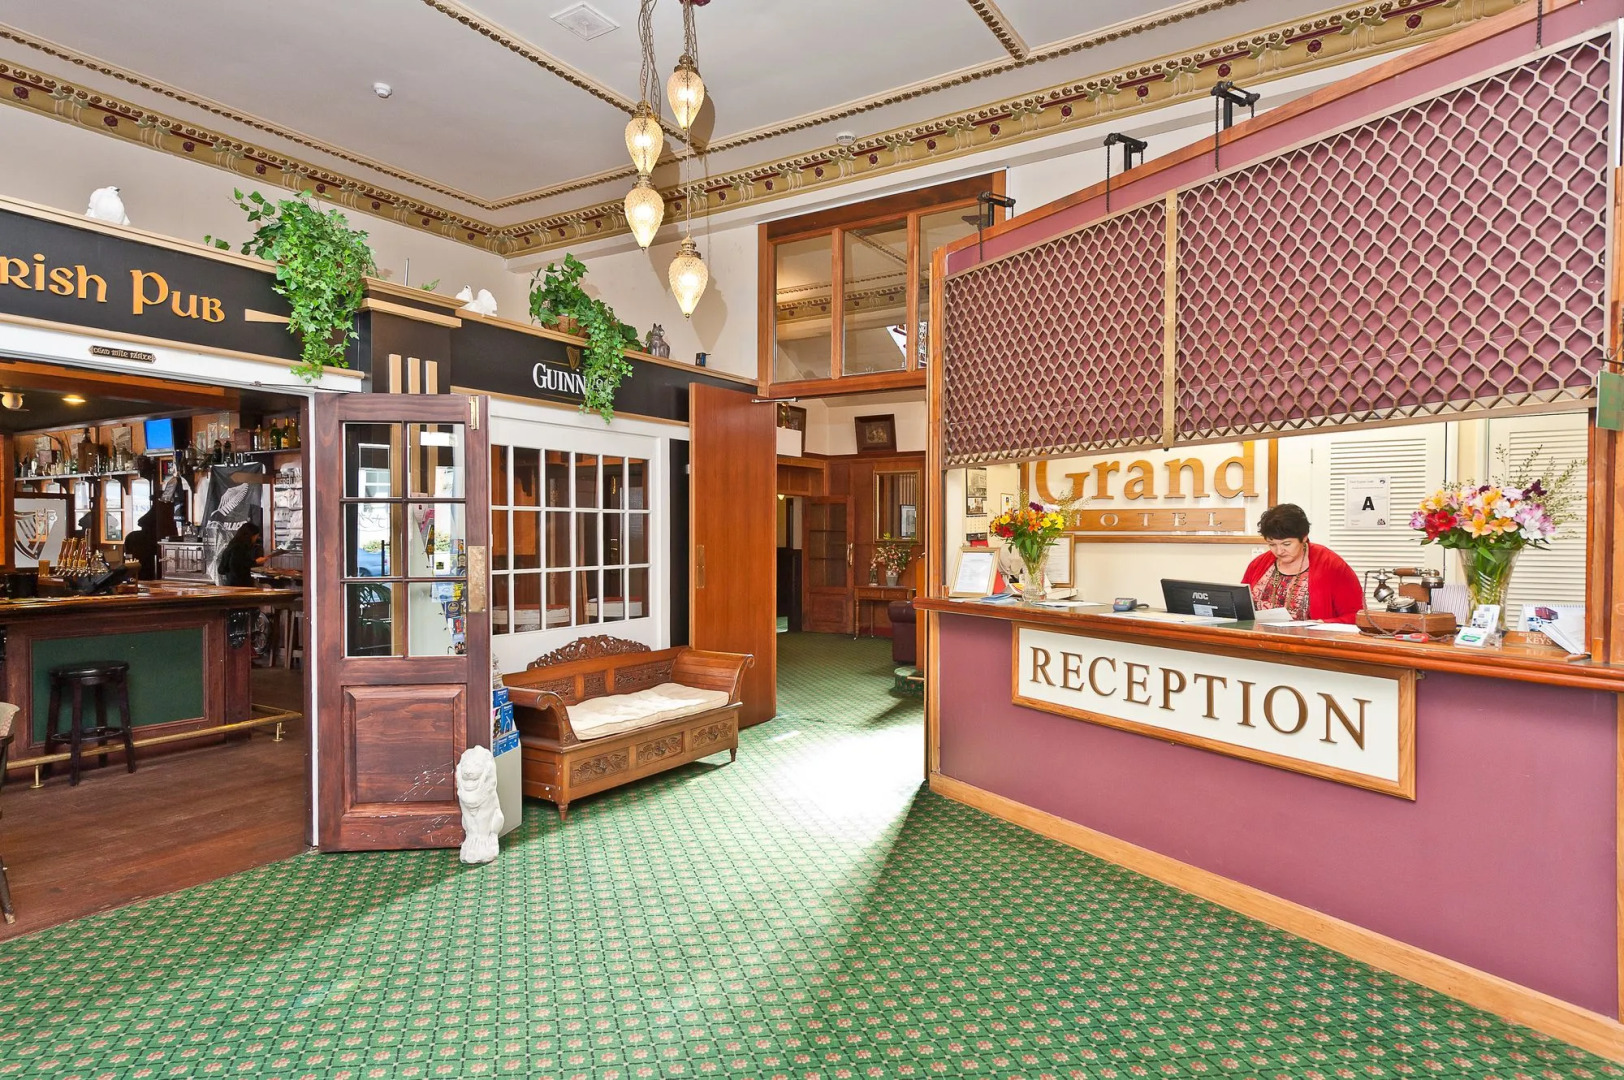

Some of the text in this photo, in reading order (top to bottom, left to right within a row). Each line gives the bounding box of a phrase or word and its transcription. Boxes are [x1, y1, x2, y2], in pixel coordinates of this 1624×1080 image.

[1035, 441, 1259, 504] Grand
[1361, 496, 1375, 511] A
[1192, 592, 1209, 600] AOC
[1526, 637, 1552, 646] KEYS
[1030, 646, 1373, 751] RECEPTION
